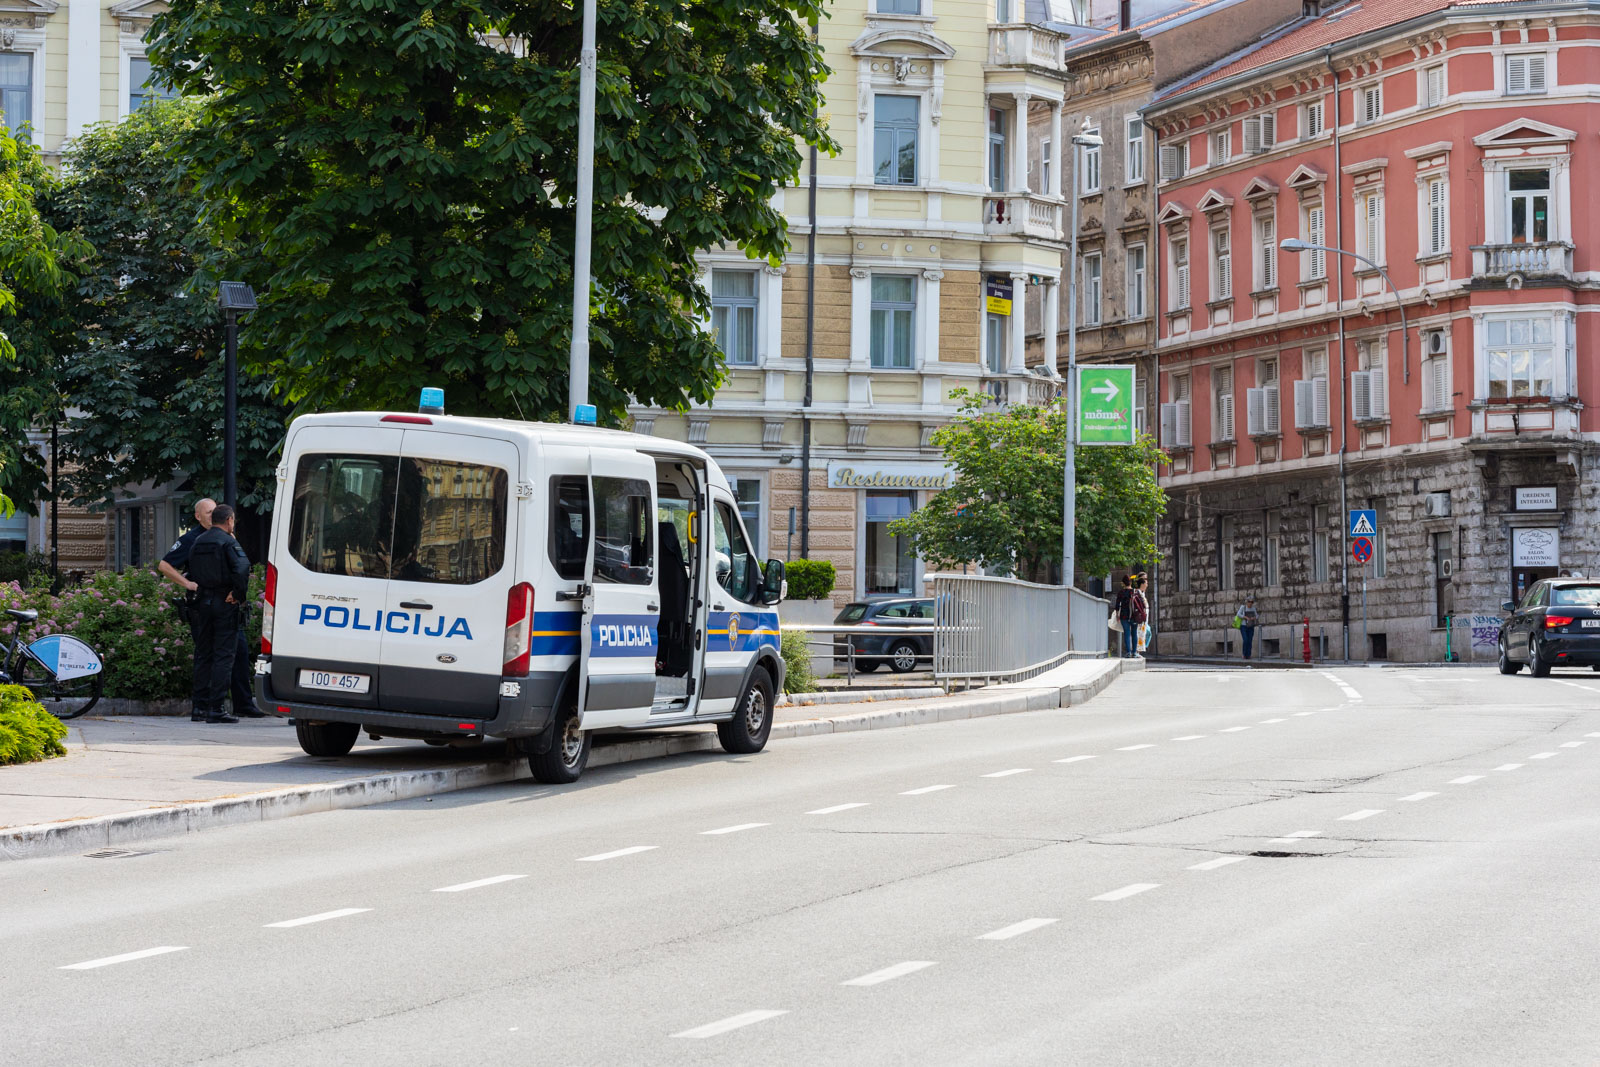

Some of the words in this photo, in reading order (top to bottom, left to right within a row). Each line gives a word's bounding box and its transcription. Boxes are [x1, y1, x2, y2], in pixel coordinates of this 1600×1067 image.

[1084, 408, 1128, 422] mömax
[834, 468, 950, 487] Restaurant
[311, 594, 358, 603] TRANSIT
[299, 604, 473, 640] POLICIJA
[599, 625, 652, 647] POLICIJA
[311, 672, 330, 685] 100
[339, 675, 360, 689] 457
